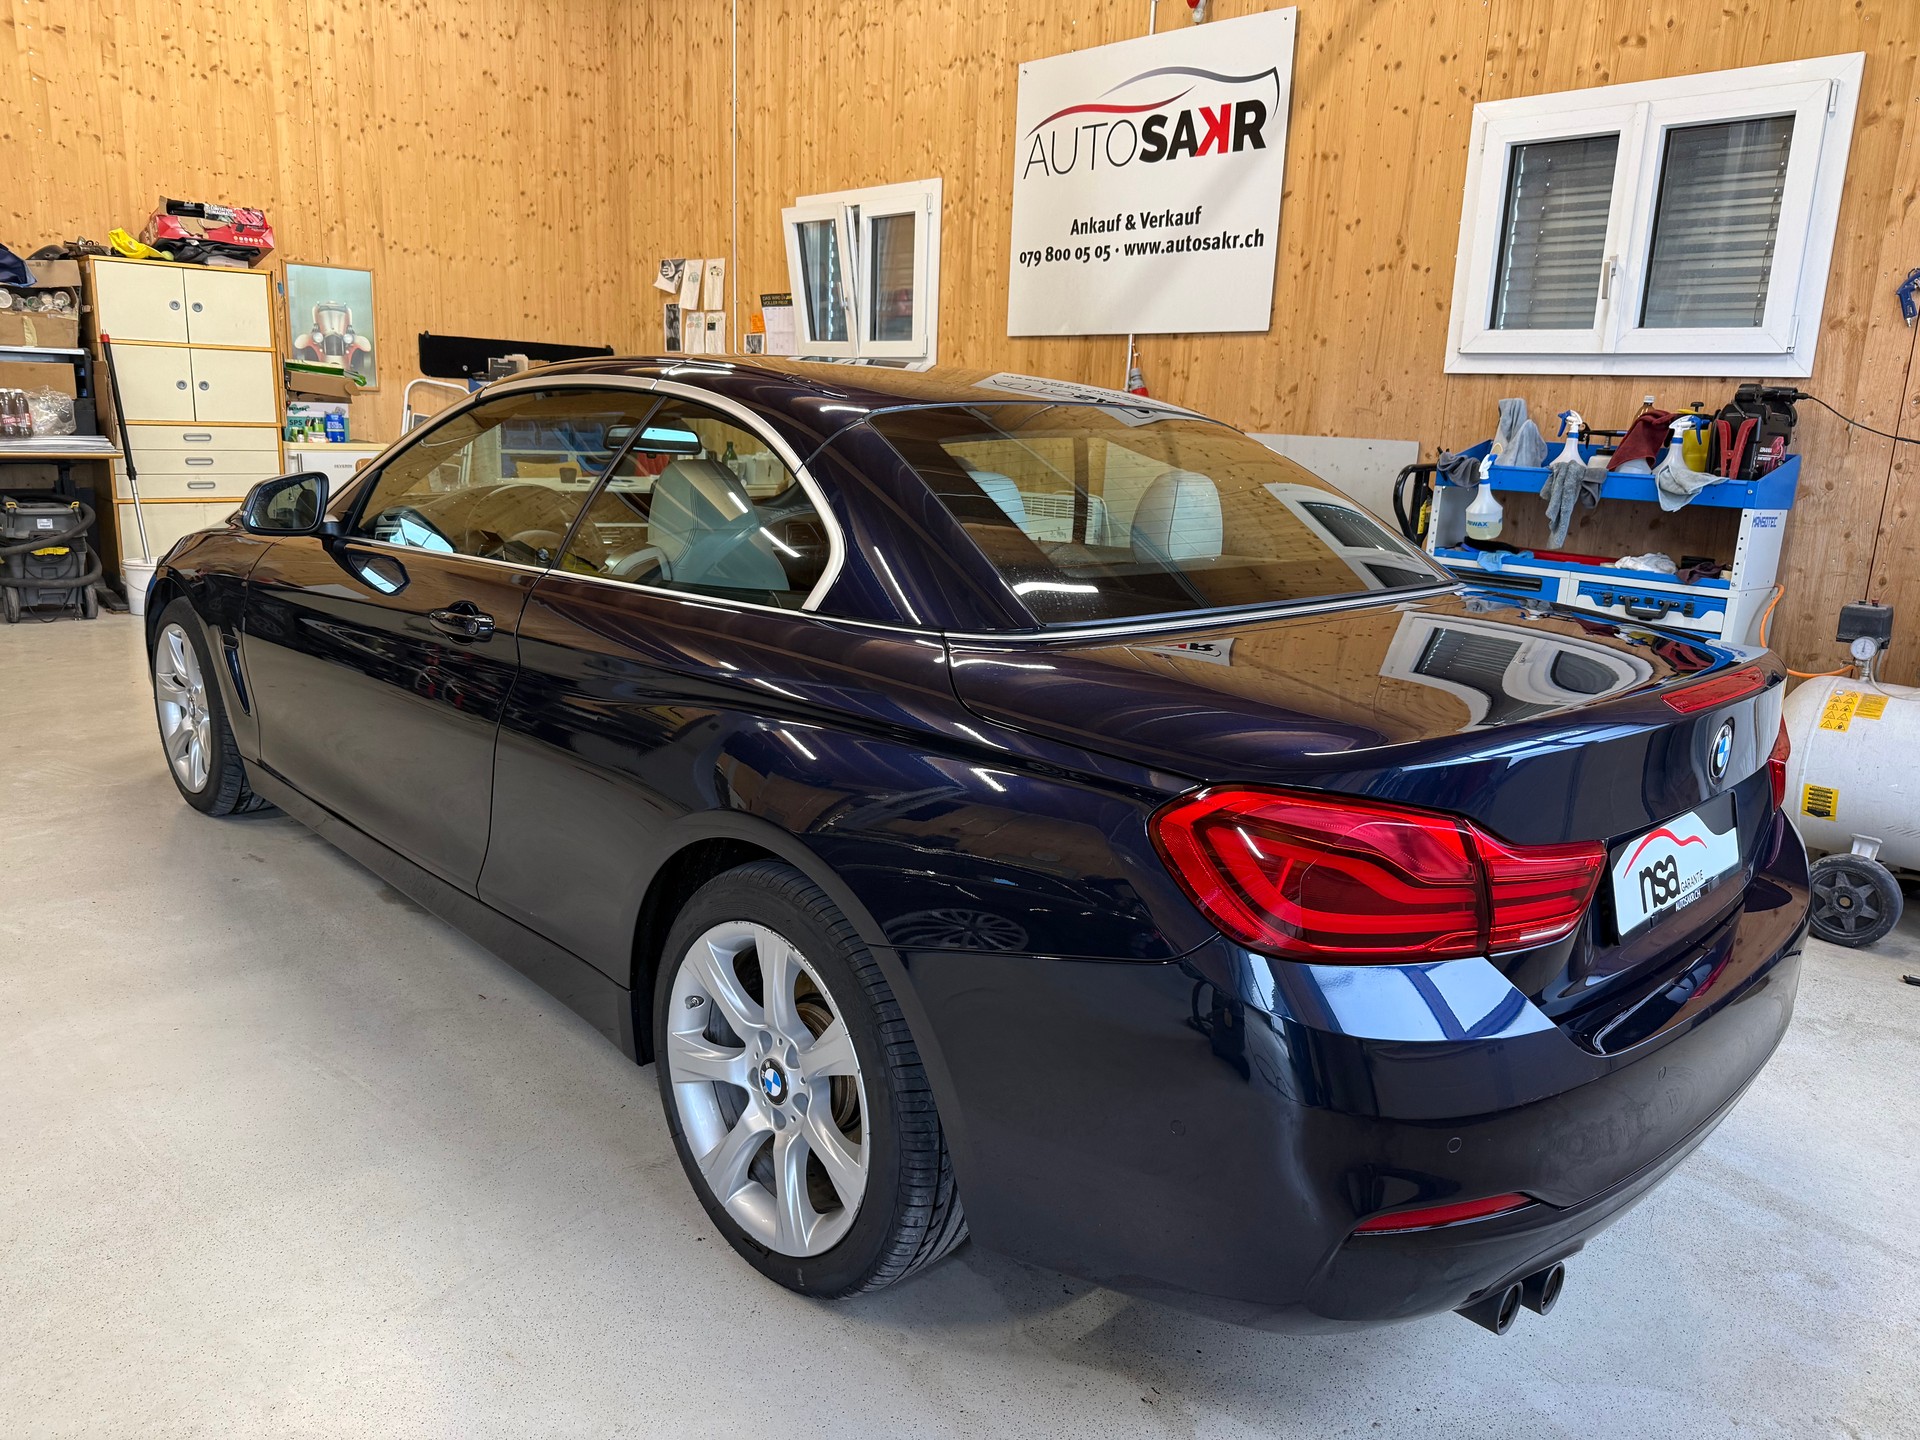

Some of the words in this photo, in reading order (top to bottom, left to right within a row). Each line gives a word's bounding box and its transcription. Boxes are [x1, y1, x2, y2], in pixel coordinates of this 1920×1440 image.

[1070, 214, 1122, 236] Ankauf
[1125, 212, 1136, 231] &
[1139, 205, 1203, 230] Verkauf
[1019, 250, 1042, 268] 079
[1045, 246, 1071, 263] 800
[1075, 247, 1090, 264] 05
[1095, 245, 1111, 261] 05
[1124, 229, 1264, 257] www.autosakr.ch
[1638, 854, 1681, 915] nsa
